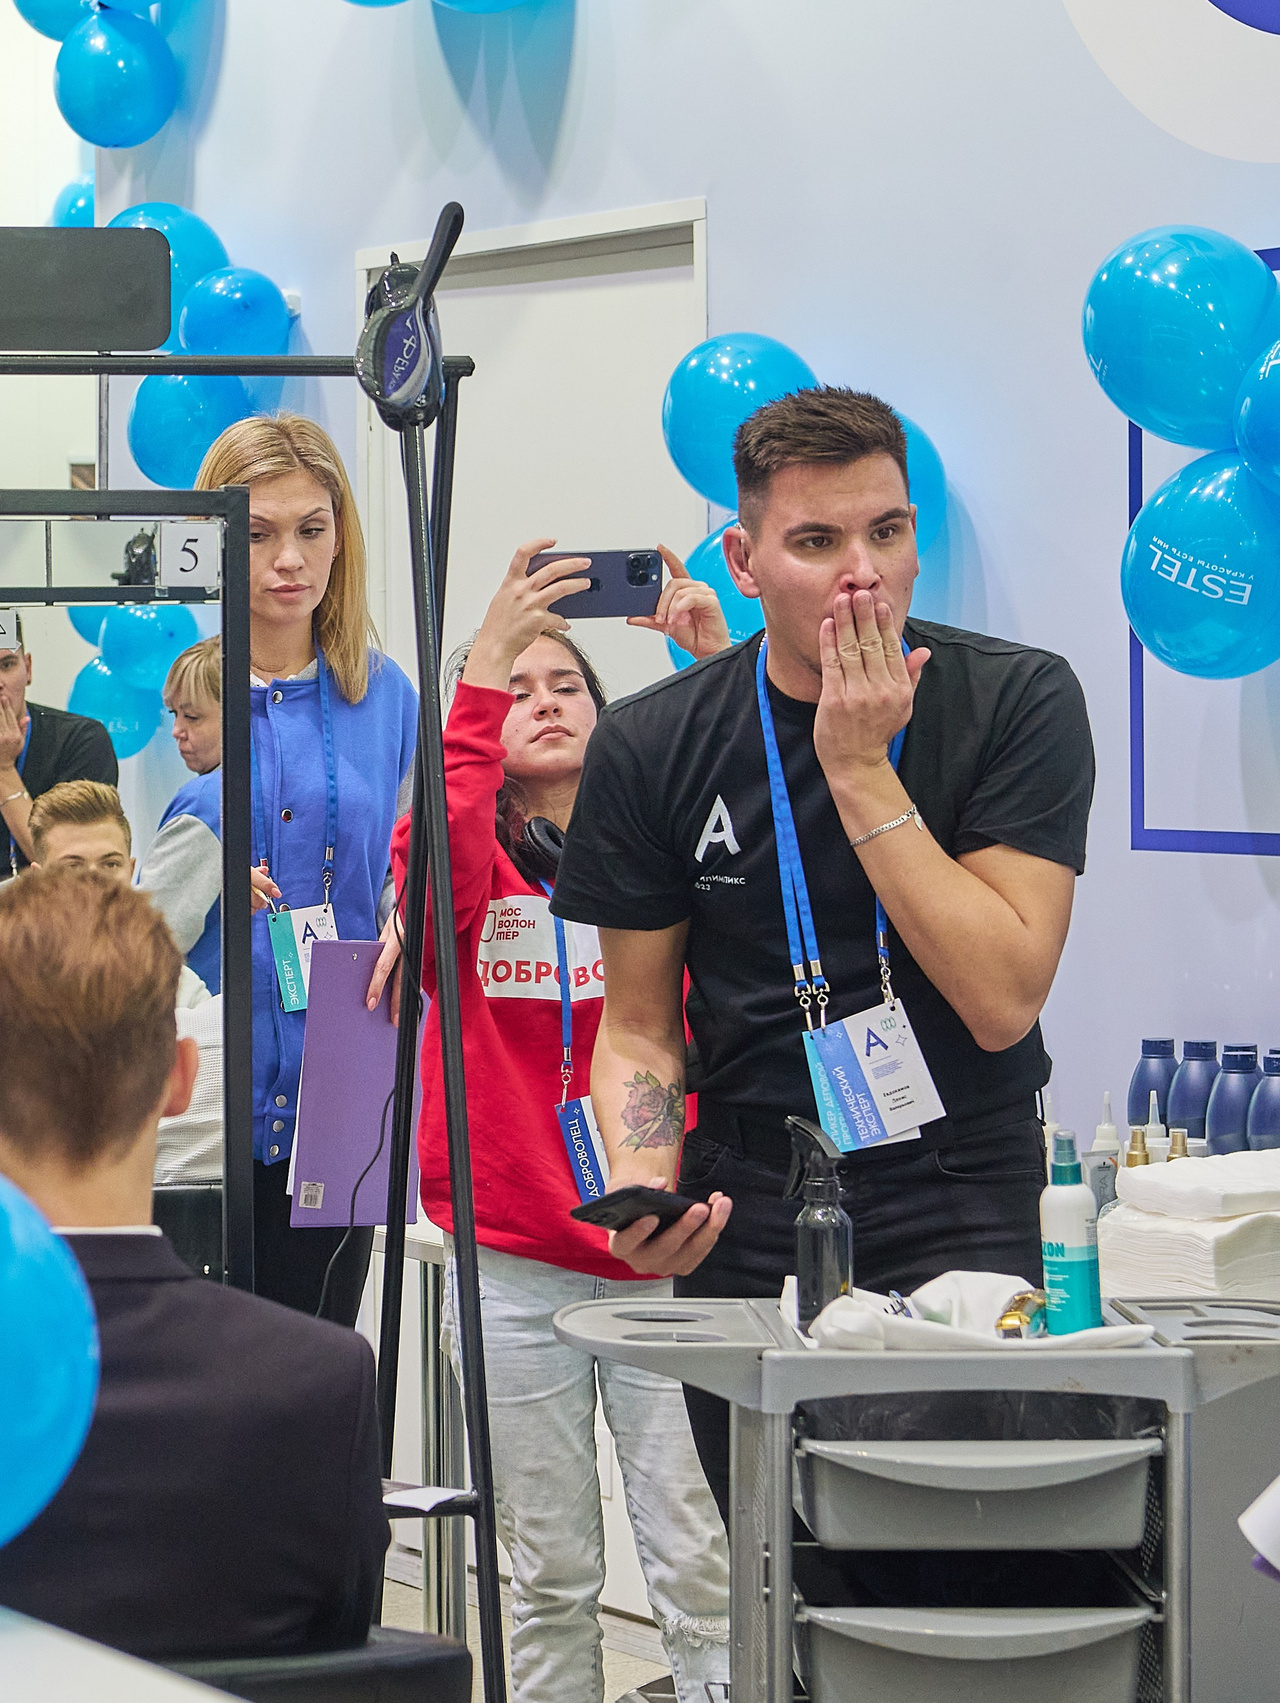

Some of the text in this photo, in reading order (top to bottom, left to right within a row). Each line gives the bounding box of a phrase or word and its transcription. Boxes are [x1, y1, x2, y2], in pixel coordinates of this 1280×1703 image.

[179, 538, 199, 572] 5
[1152, 536, 1169, 550] ИМЯ
[1171, 547, 1194, 562] ЕСТЬ
[1149, 544, 1252, 606] ESTEL
[1197, 559, 1245, 578] КРАСОТЫ
[497, 919, 536, 929] ВОЛОН
[500, 908, 521, 917] МОС
[283, 960, 299, 1006] ЭКСПЕРТ
[815, 1062, 841, 1147] СПИКЕР ДЕЛОВОЙ
[832, 1066, 869, 1142] ТЕХНИЧЕСКИЙ
[856, 1093, 881, 1136] ЭКСПЕРТ
[568, 1119, 600, 1197] ДОБРОВОЛЕЦ
